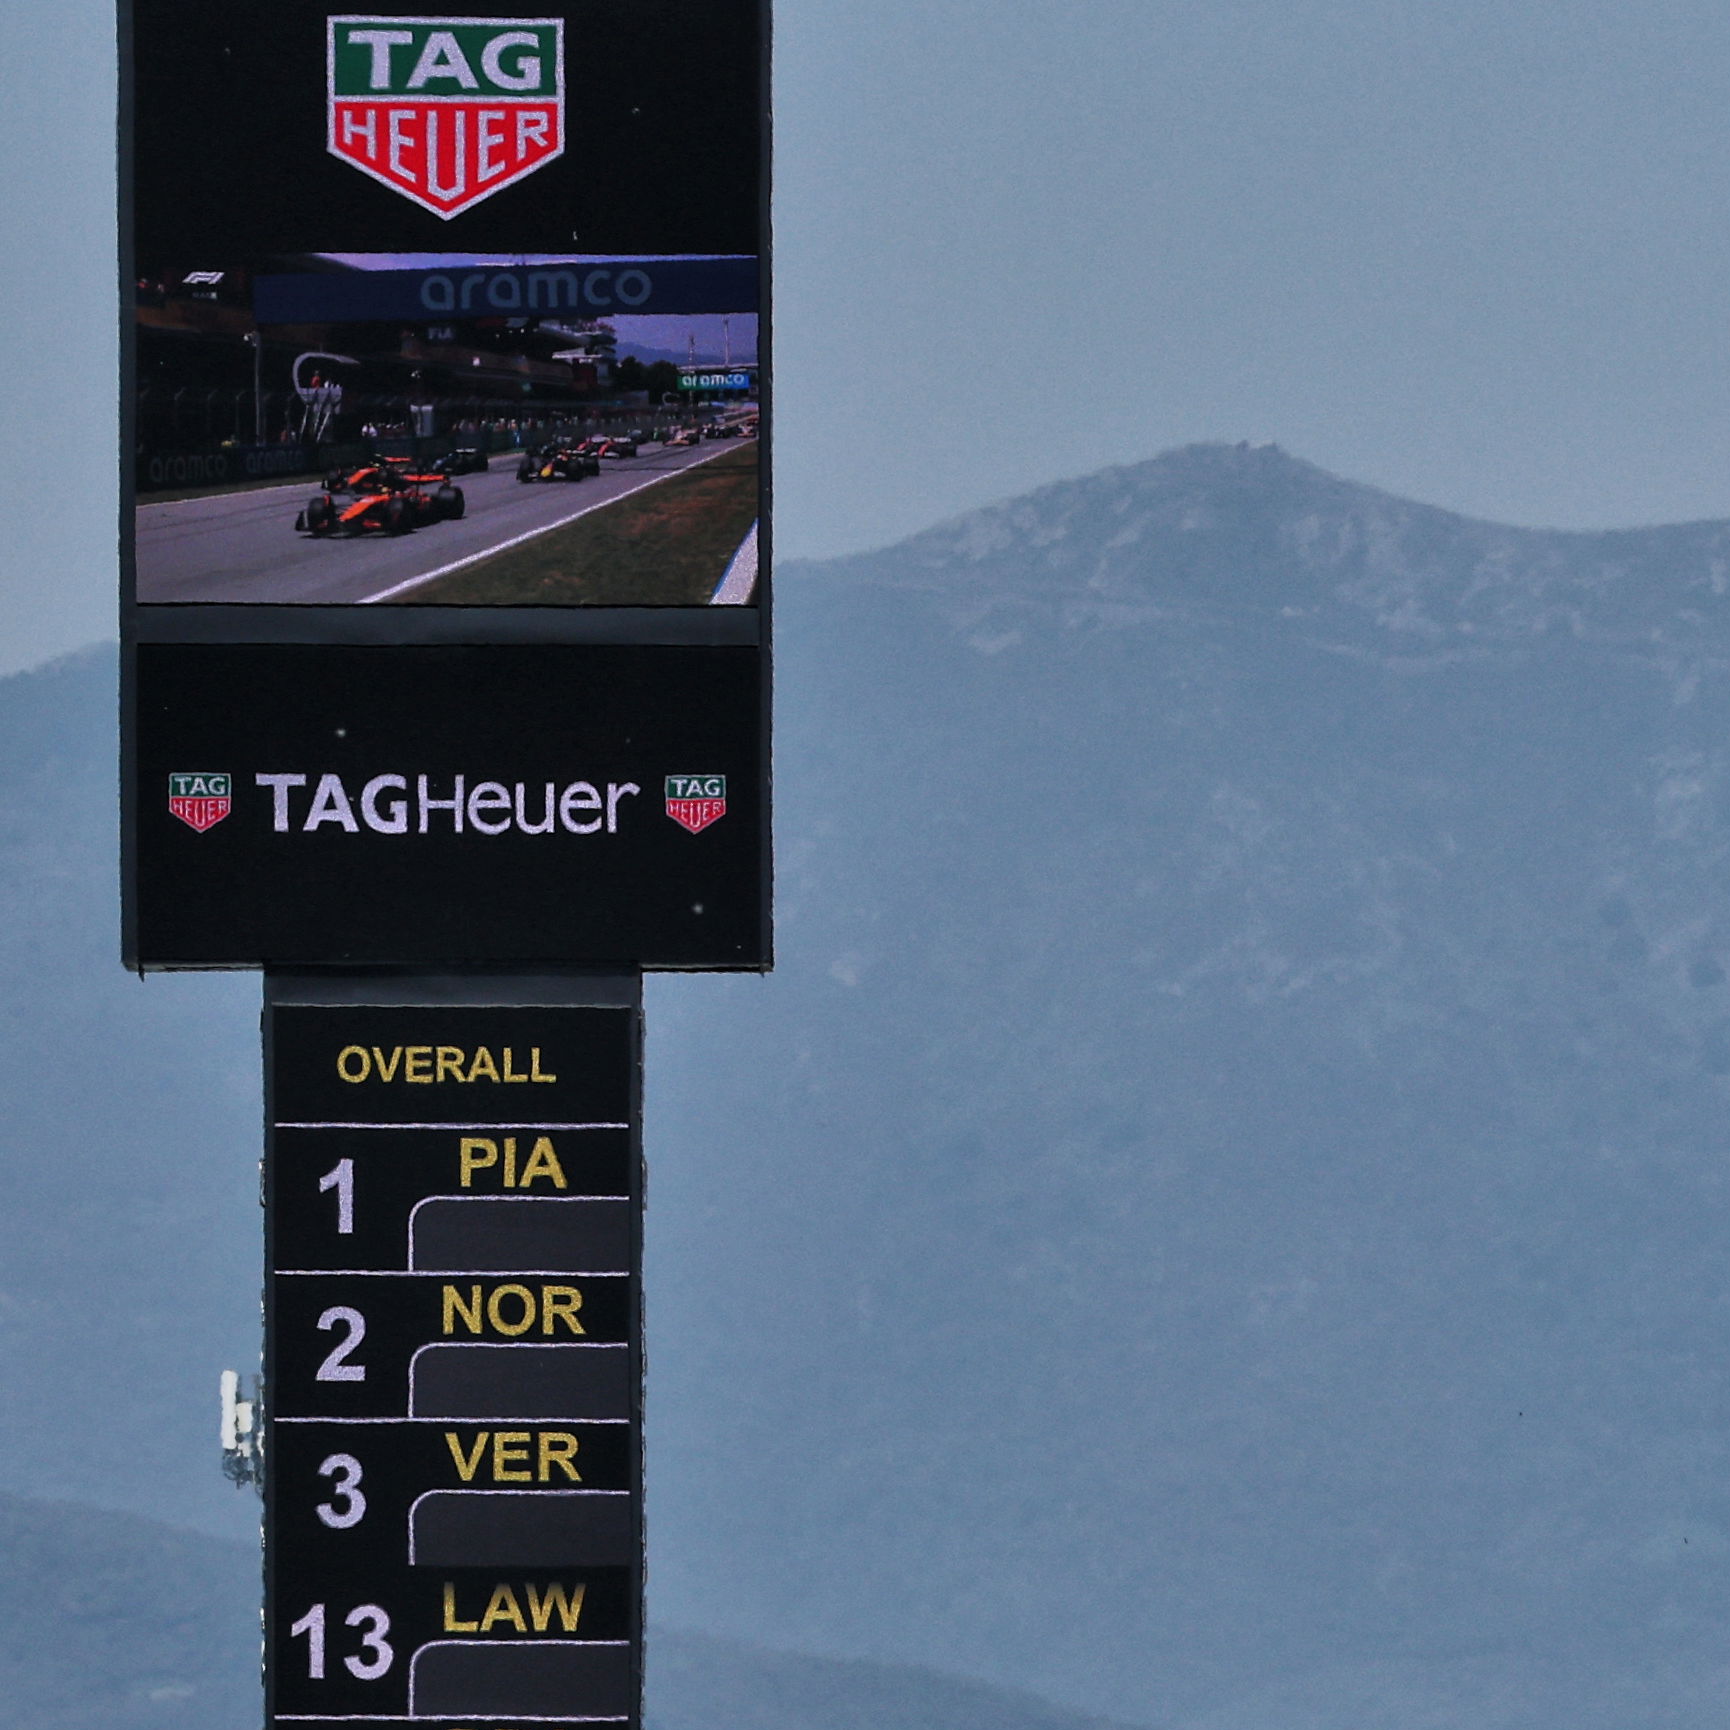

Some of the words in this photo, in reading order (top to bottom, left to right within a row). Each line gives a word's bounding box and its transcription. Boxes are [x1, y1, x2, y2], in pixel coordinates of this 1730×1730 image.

[347, 30, 542, 91] TAG
[342, 108, 550, 202] HEUER
[420, 269, 652, 311] aramco
[682, 373, 746, 388] aramco
[173, 776, 228, 797] TAG
[668, 778, 722, 798] TAG
[172, 799, 231, 828] HEUER
[666, 801, 724, 829] HEUER
[337, 1045, 557, 1084] OVERALL
[319, 1158, 354, 1234] 1
[459, 1136, 568, 1189] PIA
[315, 1305, 367, 1382] 2
[442, 1283, 587, 1336] NOR
[315, 1453, 367, 1529] 3
[444, 1431, 582, 1482] VER
[290, 1603, 395, 1681] 13
[442, 1581, 586, 1633] LAW
